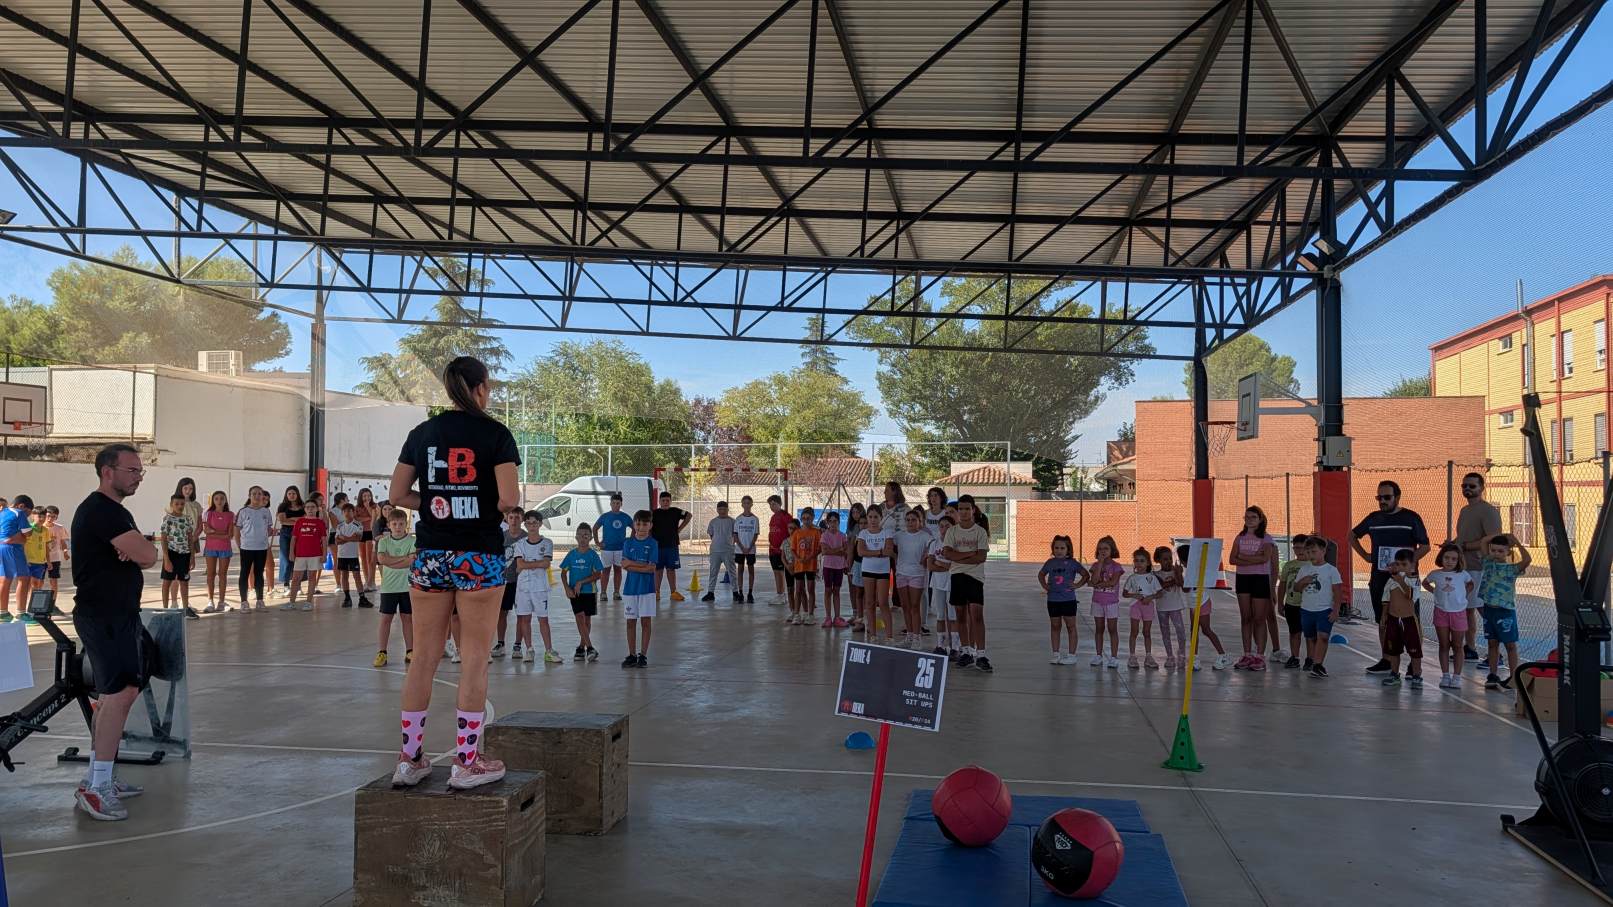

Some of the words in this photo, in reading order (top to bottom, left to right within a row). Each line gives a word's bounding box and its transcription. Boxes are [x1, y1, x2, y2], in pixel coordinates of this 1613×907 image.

[451, 496, 480, 519] DEKA
[849, 647, 866, 663] ZONE
[866, 649, 871, 665] 4
[914, 657, 936, 689] 25
[902, 689, 934, 701] MED-BALL
[905, 698, 918, 706] SIT
[920, 701, 933, 709] UPS
